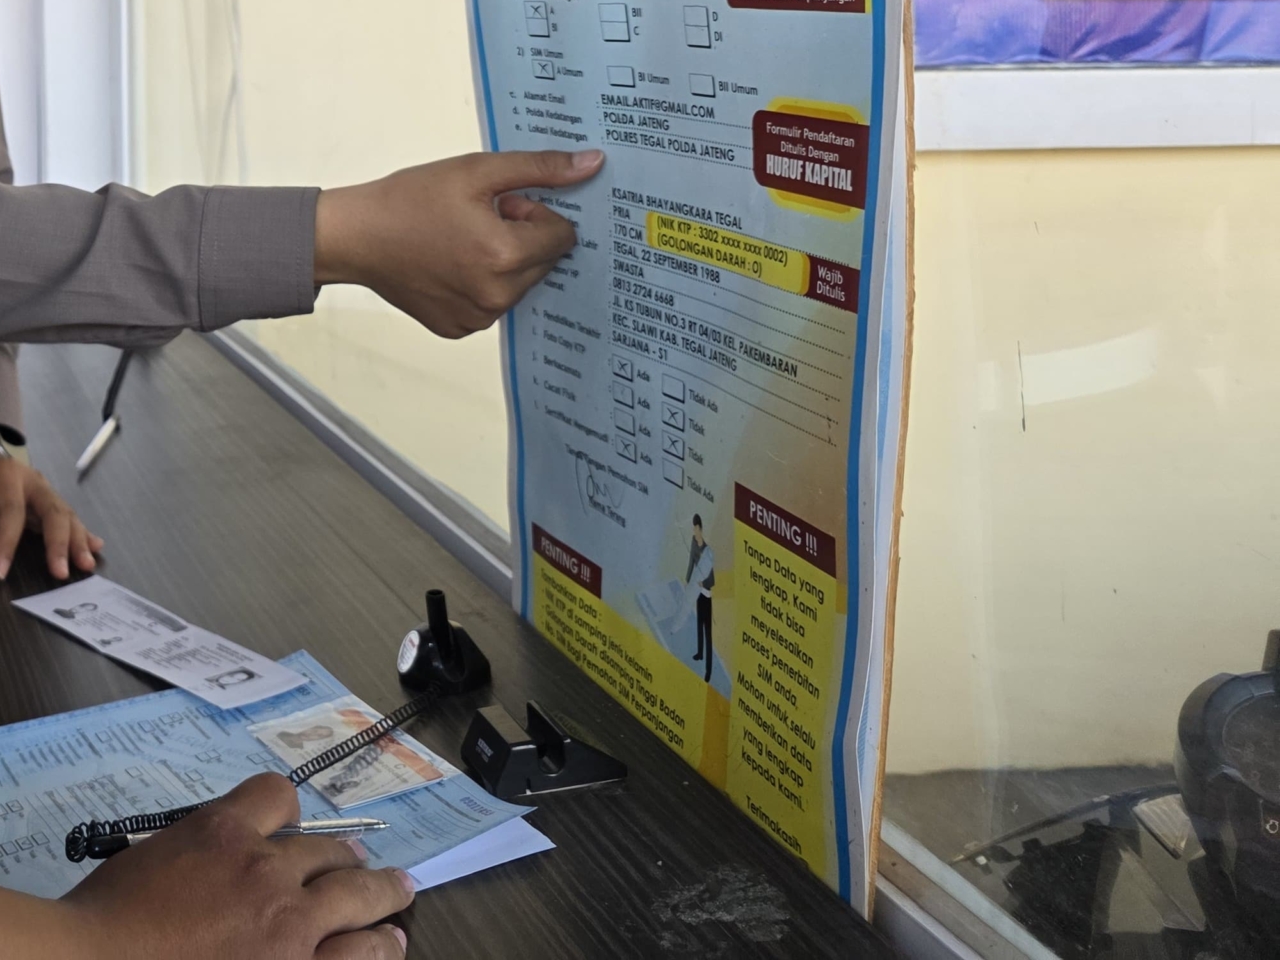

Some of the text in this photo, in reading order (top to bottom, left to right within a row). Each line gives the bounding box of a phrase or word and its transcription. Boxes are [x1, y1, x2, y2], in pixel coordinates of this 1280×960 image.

[731, 82, 758, 95] Umum
[604, 112, 669, 130] POLDA JATENG
[766, 122, 854, 147] Formulir Pendaftaran
[606, 129, 734, 161] POLRES TEGAL POLDA JATENG
[781, 142, 838, 163] Ditulis Dengan
[767, 154, 852, 191] HURUF KAPITAL
[612, 187, 742, 230] KSATRIA BHAYANGKARA TEGAL
[613, 205, 630, 220] PRIA
[657, 216, 675, 232] (NIK
[677, 222, 692, 235] KTP
[699, 226, 718, 242] 3302
[614, 223, 746, 270] 170 CM (GOLONGAN DARAH
[641, 248, 651, 261] 22
[653, 251, 698, 276] SEPTEMBER
[701, 266, 720, 283] 1988
[612, 277, 631, 292] 0813
[633, 283, 652, 300] 2724
[613, 259, 644, 279] SWASTA
[818, 265, 843, 284] Wajib
[816, 281, 845, 302] Ditulis
[612, 312, 737, 371] KEC. SLAWI KAB. TEGAL JATENG
[612, 331, 649, 355] SARJANA
[624, 299, 635, 313] KS
[636, 303, 662, 323] TUBUN
[664, 310, 686, 330] NO.3
[688, 319, 697, 333] RT
[699, 323, 722, 345] 04/03
[739, 340, 797, 378] PAKEMBARAN
[750, 500, 817, 556] PENTING !!!
[541, 536, 578, 575] PENTING
[744, 540, 824, 605] Tanpa Data yang
[761, 595, 805, 637] tidak bisa
[793, 594, 817, 622] Kami
[751, 615, 813, 669] meyelesaikan
[742, 631, 819, 699] proses penerbitan
[757, 663, 772, 687] SIM
[635, 673, 685, 730] Tinggi Badan
[737, 671, 764, 705] Mohon
[790, 719, 815, 750] selalu
[631, 695, 684, 749] Perpanjangan
[738, 698, 812, 773] memberikan data
[742, 727, 803, 788] yang lengkap
[742, 746, 775, 787] kepada
[746, 796, 802, 855] Terimakasih
